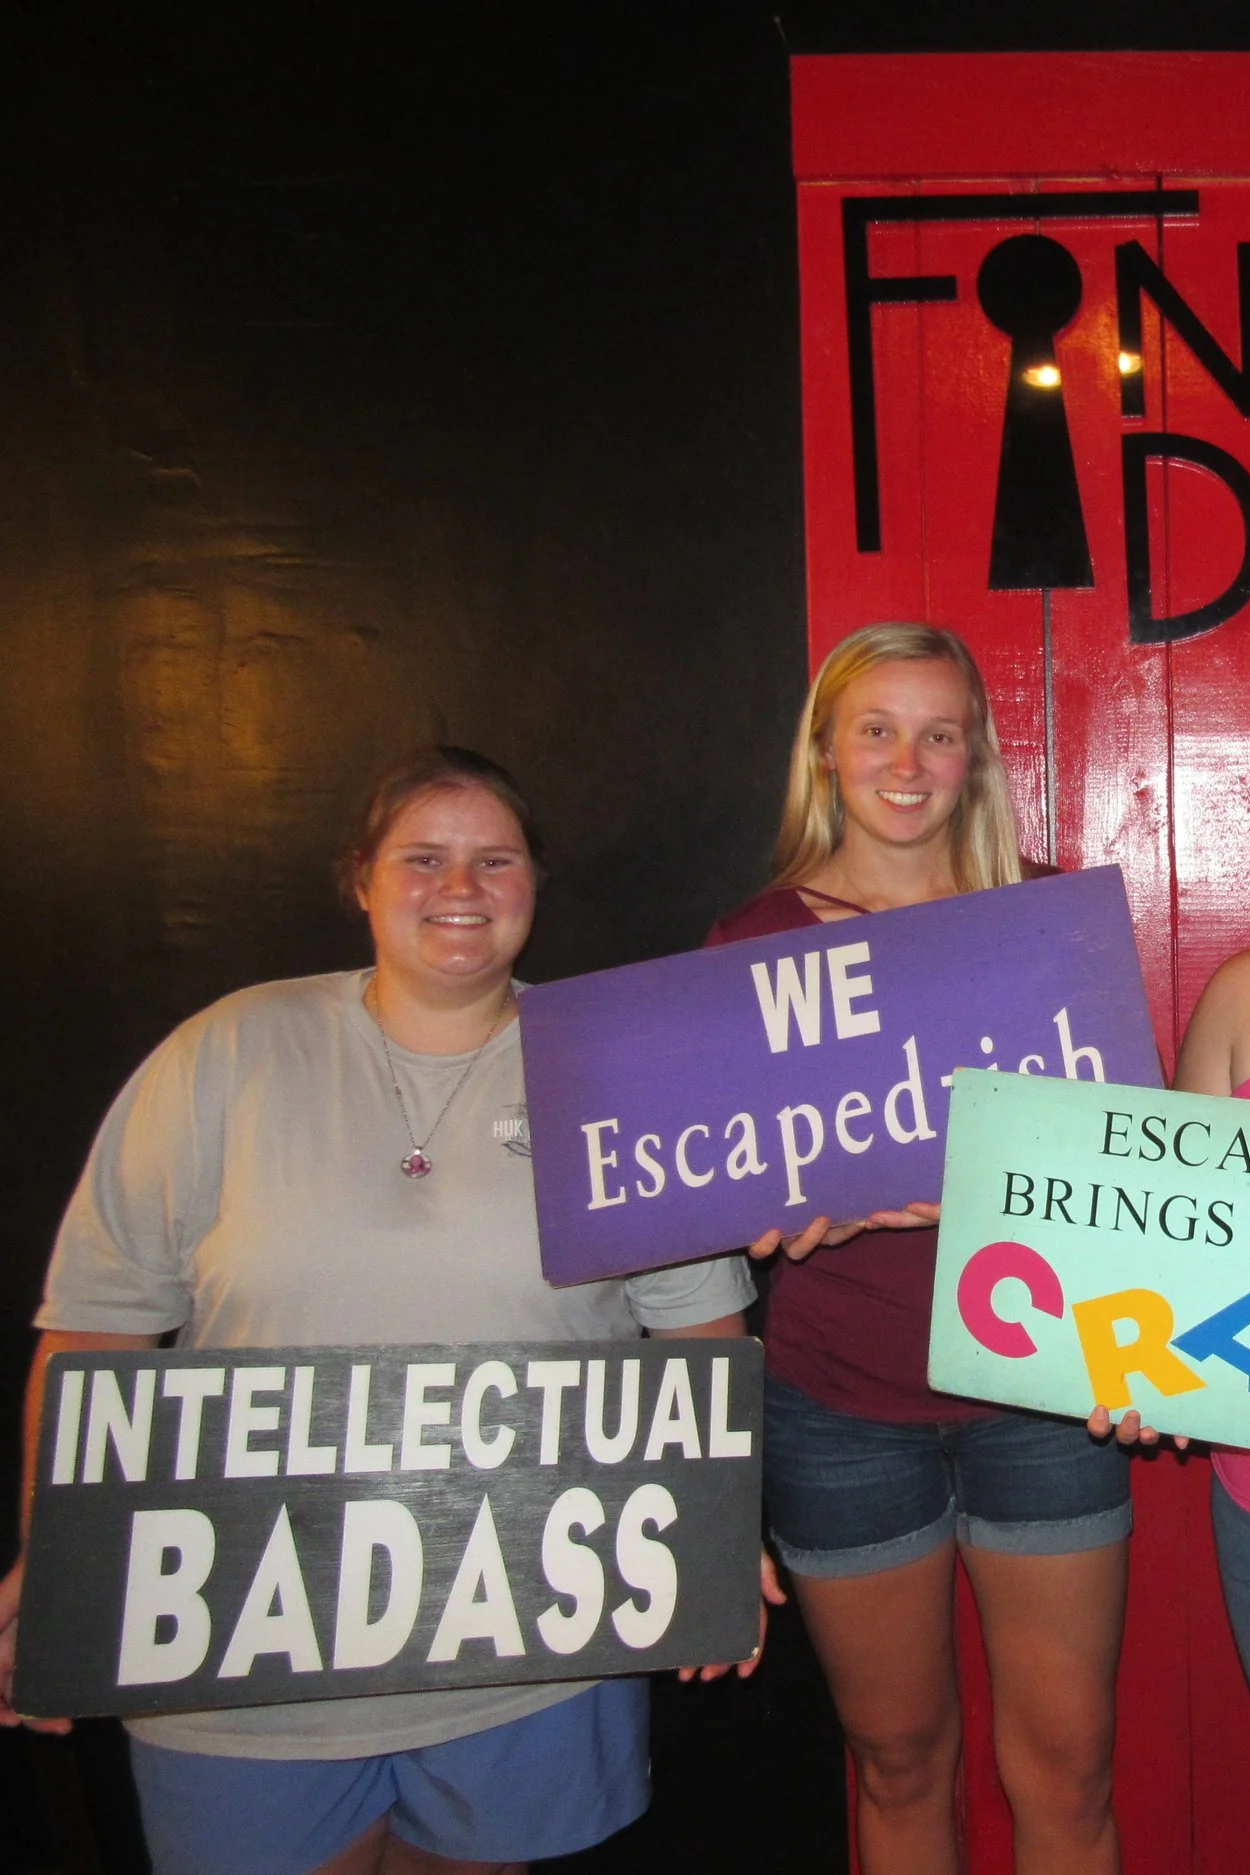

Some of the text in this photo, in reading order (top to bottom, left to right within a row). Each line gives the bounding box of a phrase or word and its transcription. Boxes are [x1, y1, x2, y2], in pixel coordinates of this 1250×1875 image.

[750, 941, 881, 1054] WE
[493, 1119, 523, 1138] HUK
[1001, 1171, 1235, 1247] BRINGS
[51, 1357, 752, 1486] INTELLECTUAL
[117, 1484, 679, 1686] BADASS
